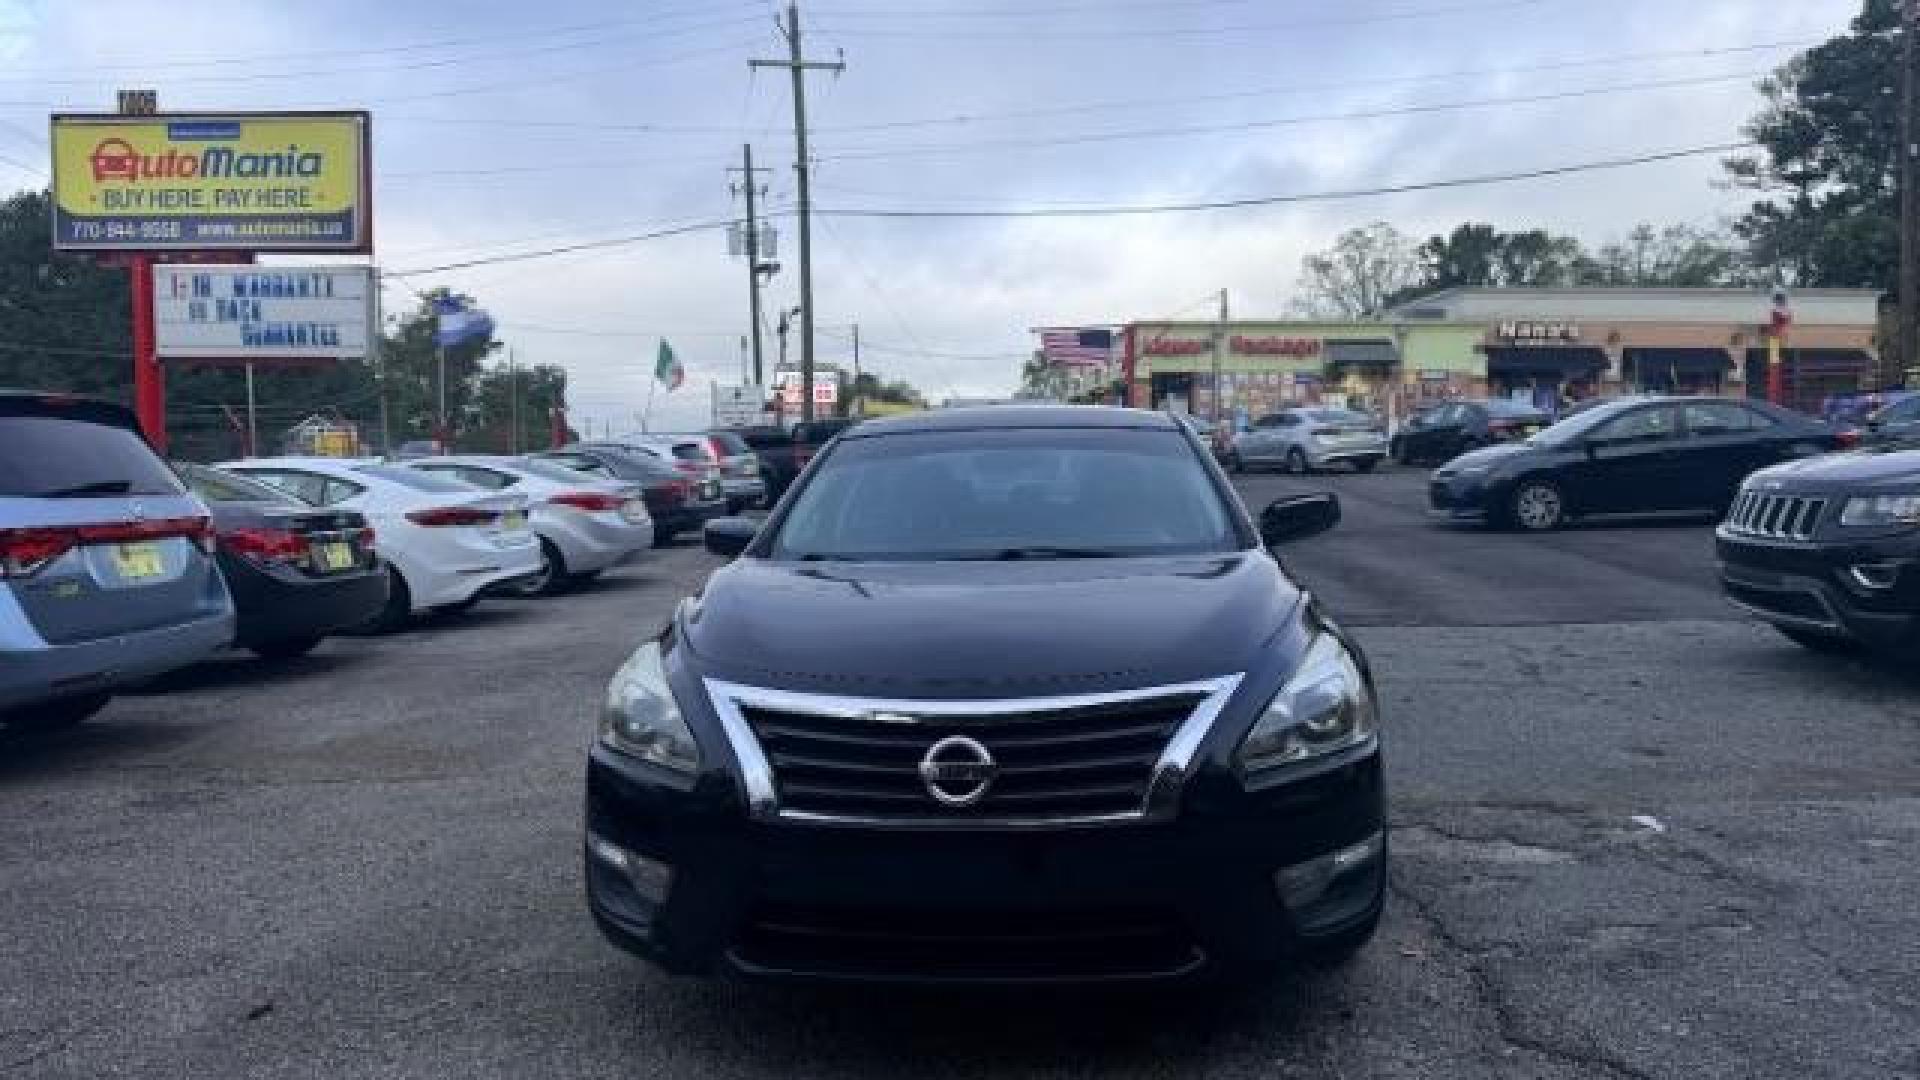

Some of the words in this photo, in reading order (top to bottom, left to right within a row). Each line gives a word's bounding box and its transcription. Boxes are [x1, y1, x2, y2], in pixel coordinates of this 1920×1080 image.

[103, 189, 145, 209] BUY
[213, 188, 252, 208] PAY
[255, 187, 313, 207] HERE
